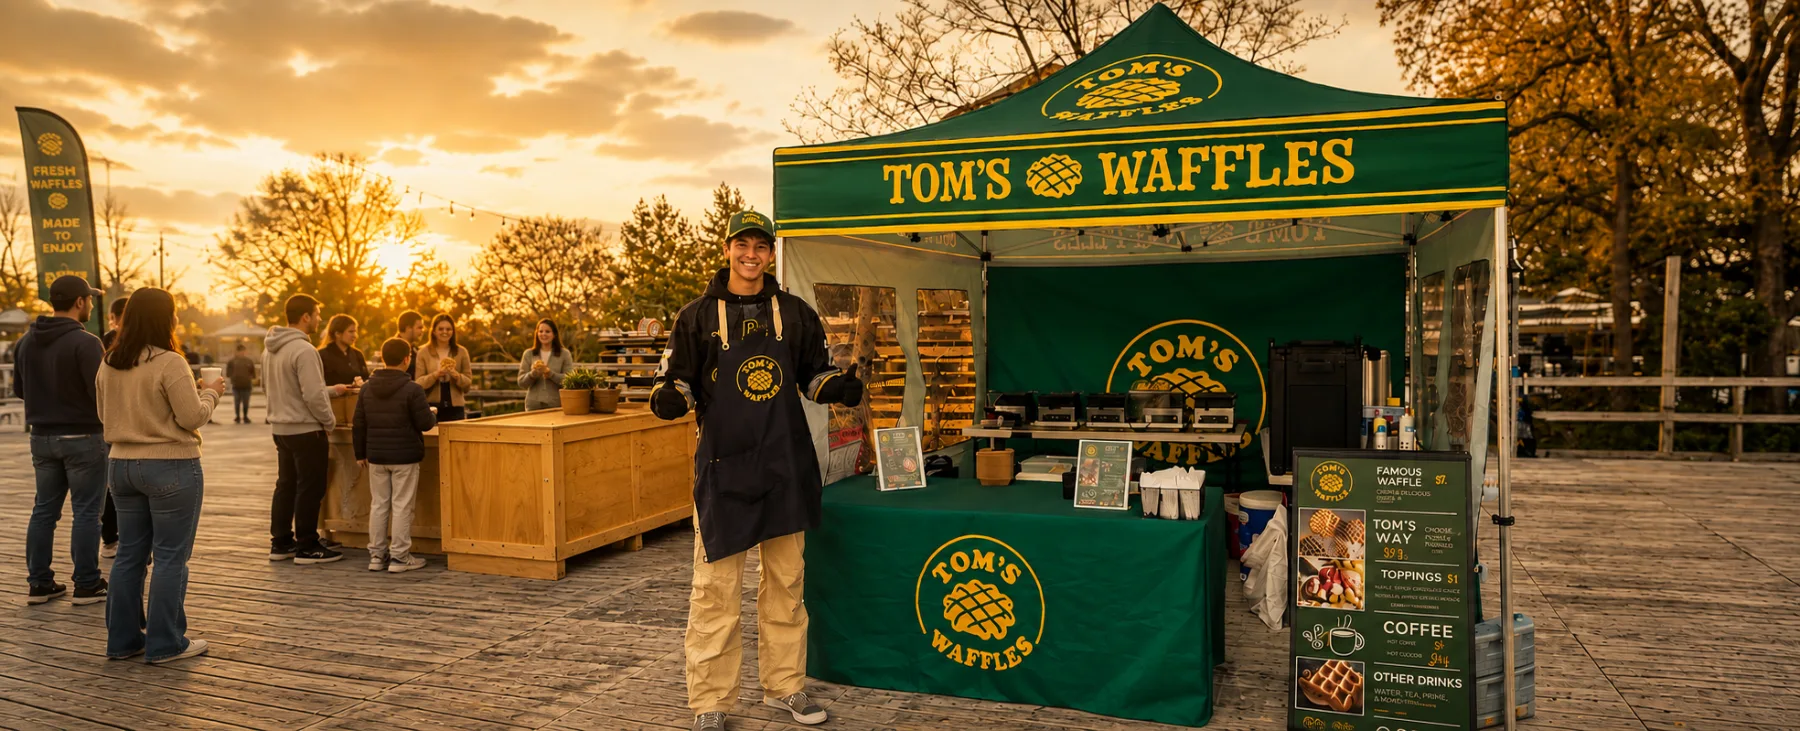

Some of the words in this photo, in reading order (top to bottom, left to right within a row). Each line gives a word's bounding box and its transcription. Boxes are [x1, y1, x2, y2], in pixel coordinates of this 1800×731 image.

[1074, 61, 1192, 90] TOM'S
[1049, 97, 1203, 121] WAFFLES
[33, 166, 76, 176] FRESH
[883, 157, 1012, 204] TOM'S
[1098, 138, 1355, 196] WAFFLES
[30, 180, 83, 189] WAFFLES
[43, 219, 80, 229] MADE
[53, 232, 71, 241] TO
[42, 243, 83, 253] ENJOY
[1127, 335, 1239, 377] TOM'S
[741, 360, 775, 374] TOM'S
[1376, 467, 1422, 477] FAMOUS
[1377, 477, 1422, 487] WAFFLE
[1373, 519, 1416, 531] TOM'S
[1375, 532, 1412, 544] WAY
[932, 549, 1022, 584] TOM'S
[1381, 569, 1442, 582] TOPPINGS
[1383, 621, 1453, 638] COFFEE
[931, 628, 1033, 671] WAFFLES
[1373, 671, 1414, 685] OTHER
[1417, 675, 1462, 689] DRINKS
[1374, 688, 1403, 697] WATER,
[1404, 691, 1421, 700] TEA,
[1422, 692, 1449, 702] PRIME,
